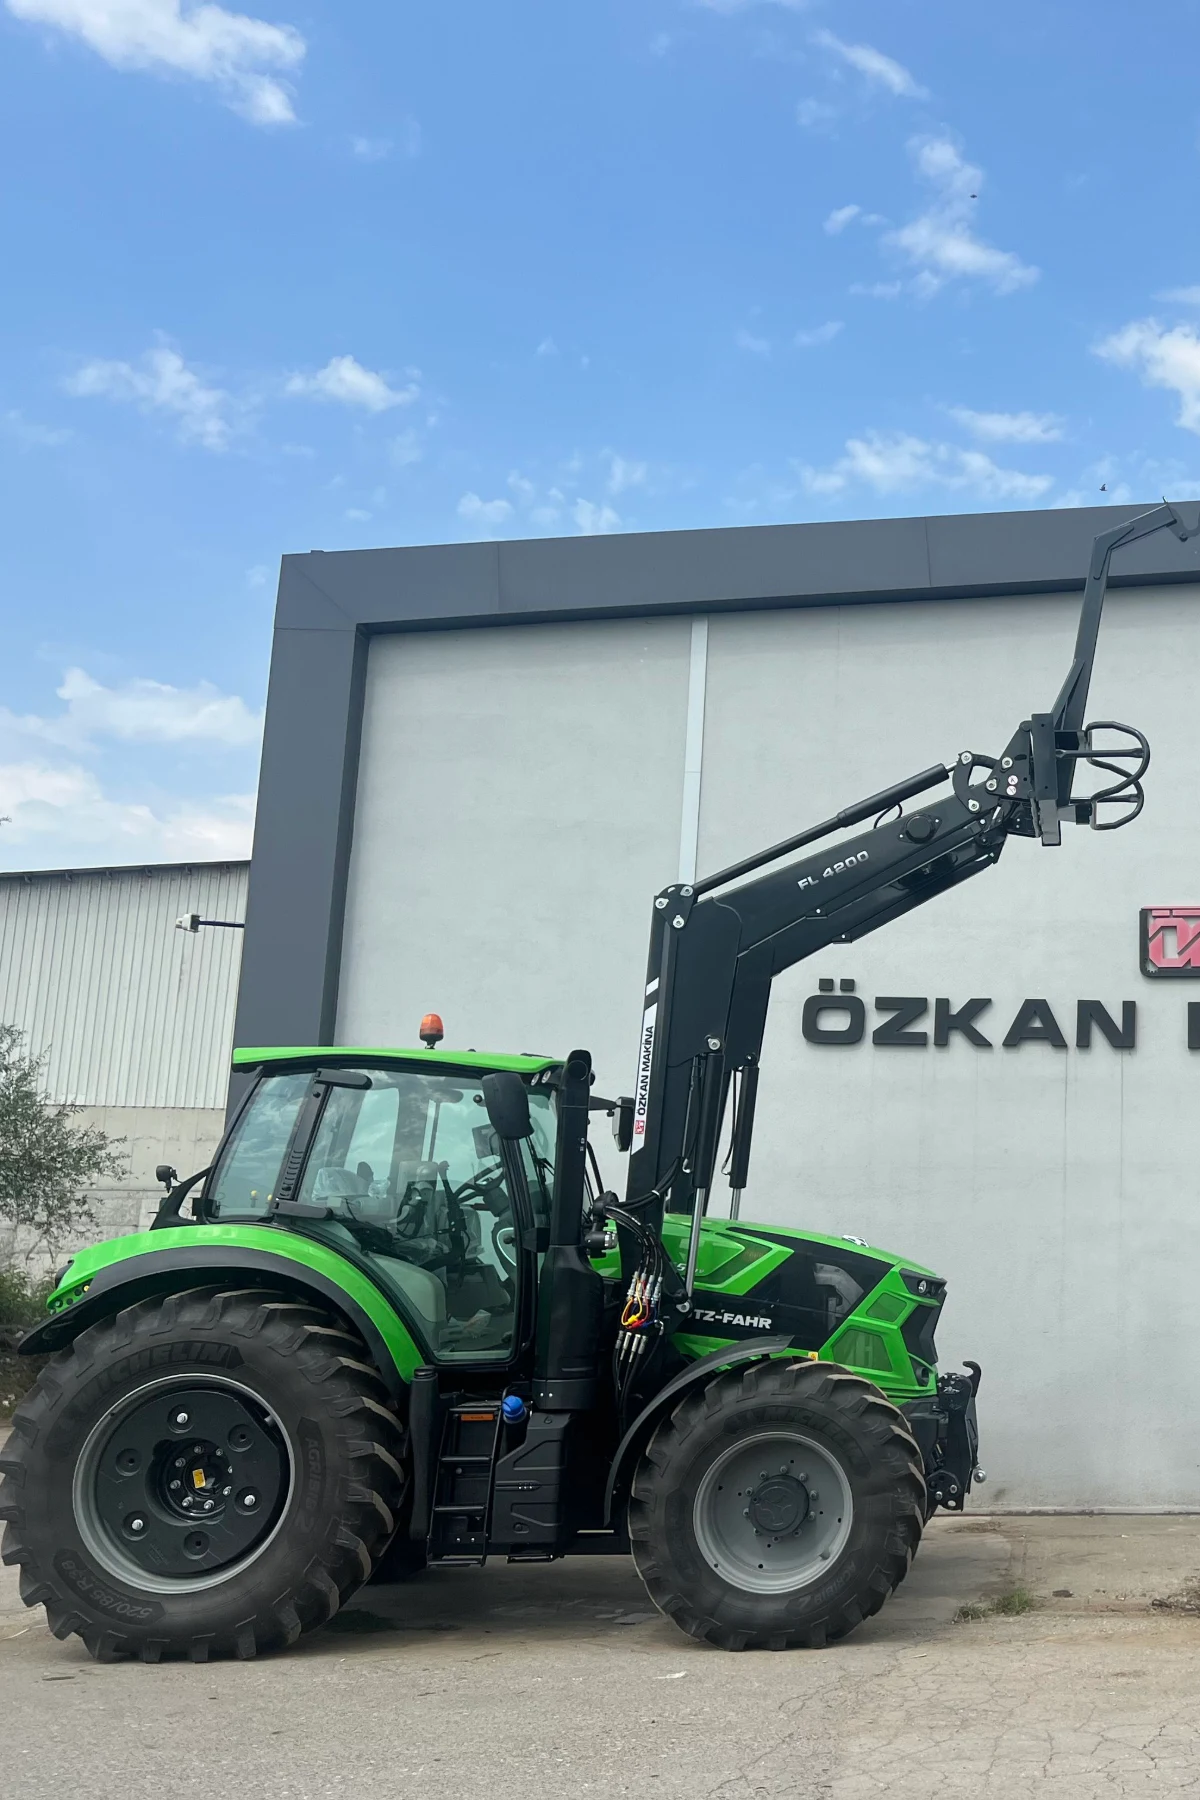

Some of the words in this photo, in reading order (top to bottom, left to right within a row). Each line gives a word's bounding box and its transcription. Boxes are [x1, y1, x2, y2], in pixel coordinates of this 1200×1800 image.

[797, 876, 820, 891] FL
[822, 850, 870, 878] 4200
[802, 978, 1137, 1048] ÖZKAN
[641, 1025, 654, 1072] MAKİNA
[636, 1075, 649, 1116] ÖZKAN
[688, 1308, 773, 1329] TZ-FAHR
[72, 1341, 230, 1405] MICHELIN
